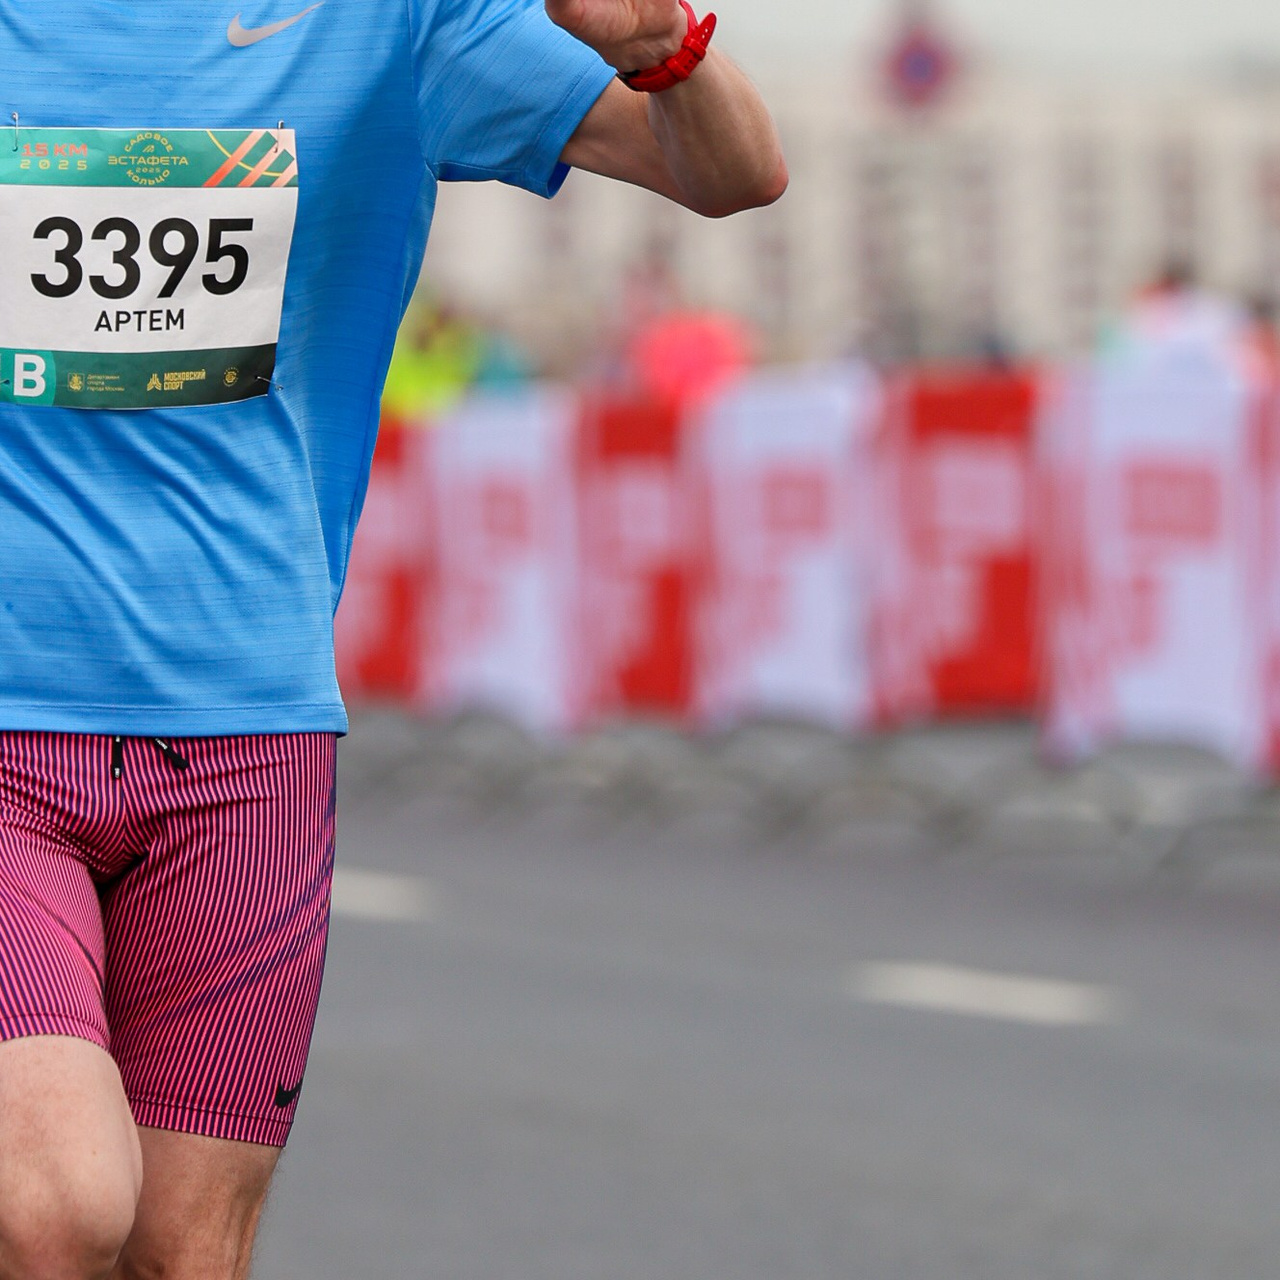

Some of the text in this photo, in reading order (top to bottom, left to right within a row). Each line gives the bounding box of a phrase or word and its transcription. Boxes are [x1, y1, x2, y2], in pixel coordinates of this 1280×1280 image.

[21, 143, 88, 157] 15 КМ
[124, 132, 173, 153] САДОВОЕ
[20, 159, 88, 170] 2025
[108, 155, 189, 166] ЭСТАФЕТА
[126, 169, 170, 186] КОЛЬЦО
[30, 216, 254, 299] 3395
[94, 308, 185, 332] АРТЕМ
[163, 381, 184, 390] СПОРТ
